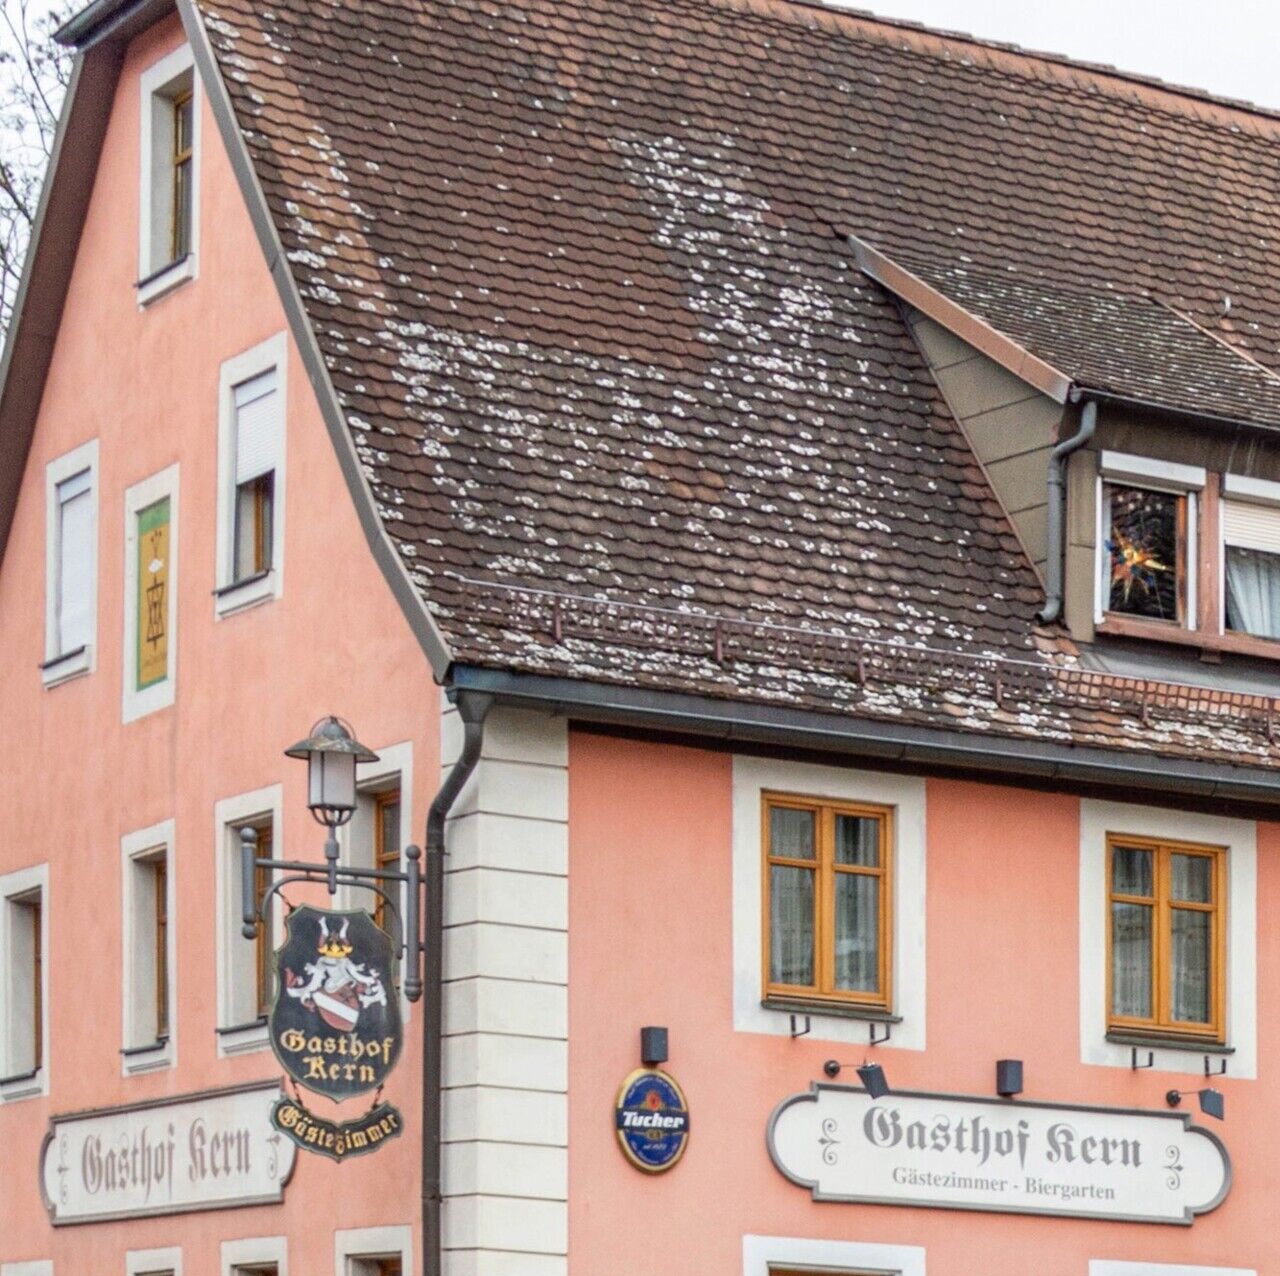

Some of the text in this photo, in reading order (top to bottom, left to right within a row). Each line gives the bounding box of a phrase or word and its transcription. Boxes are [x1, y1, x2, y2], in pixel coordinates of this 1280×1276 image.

[280, 1028, 395, 1065] Gasthof
[302, 1055, 375, 1082] Kern
[278, 1105, 398, 1155] Gästezimmer
[622, 1111, 685, 1128] Tucher
[862, 1105, 1142, 1170] Gasthof Kern
[82, 1117, 251, 1203] Gasthof Kern
[892, 1165, 1008, 1192] Gästezimmer
[1025, 1176, 1116, 1200] Biergarten
